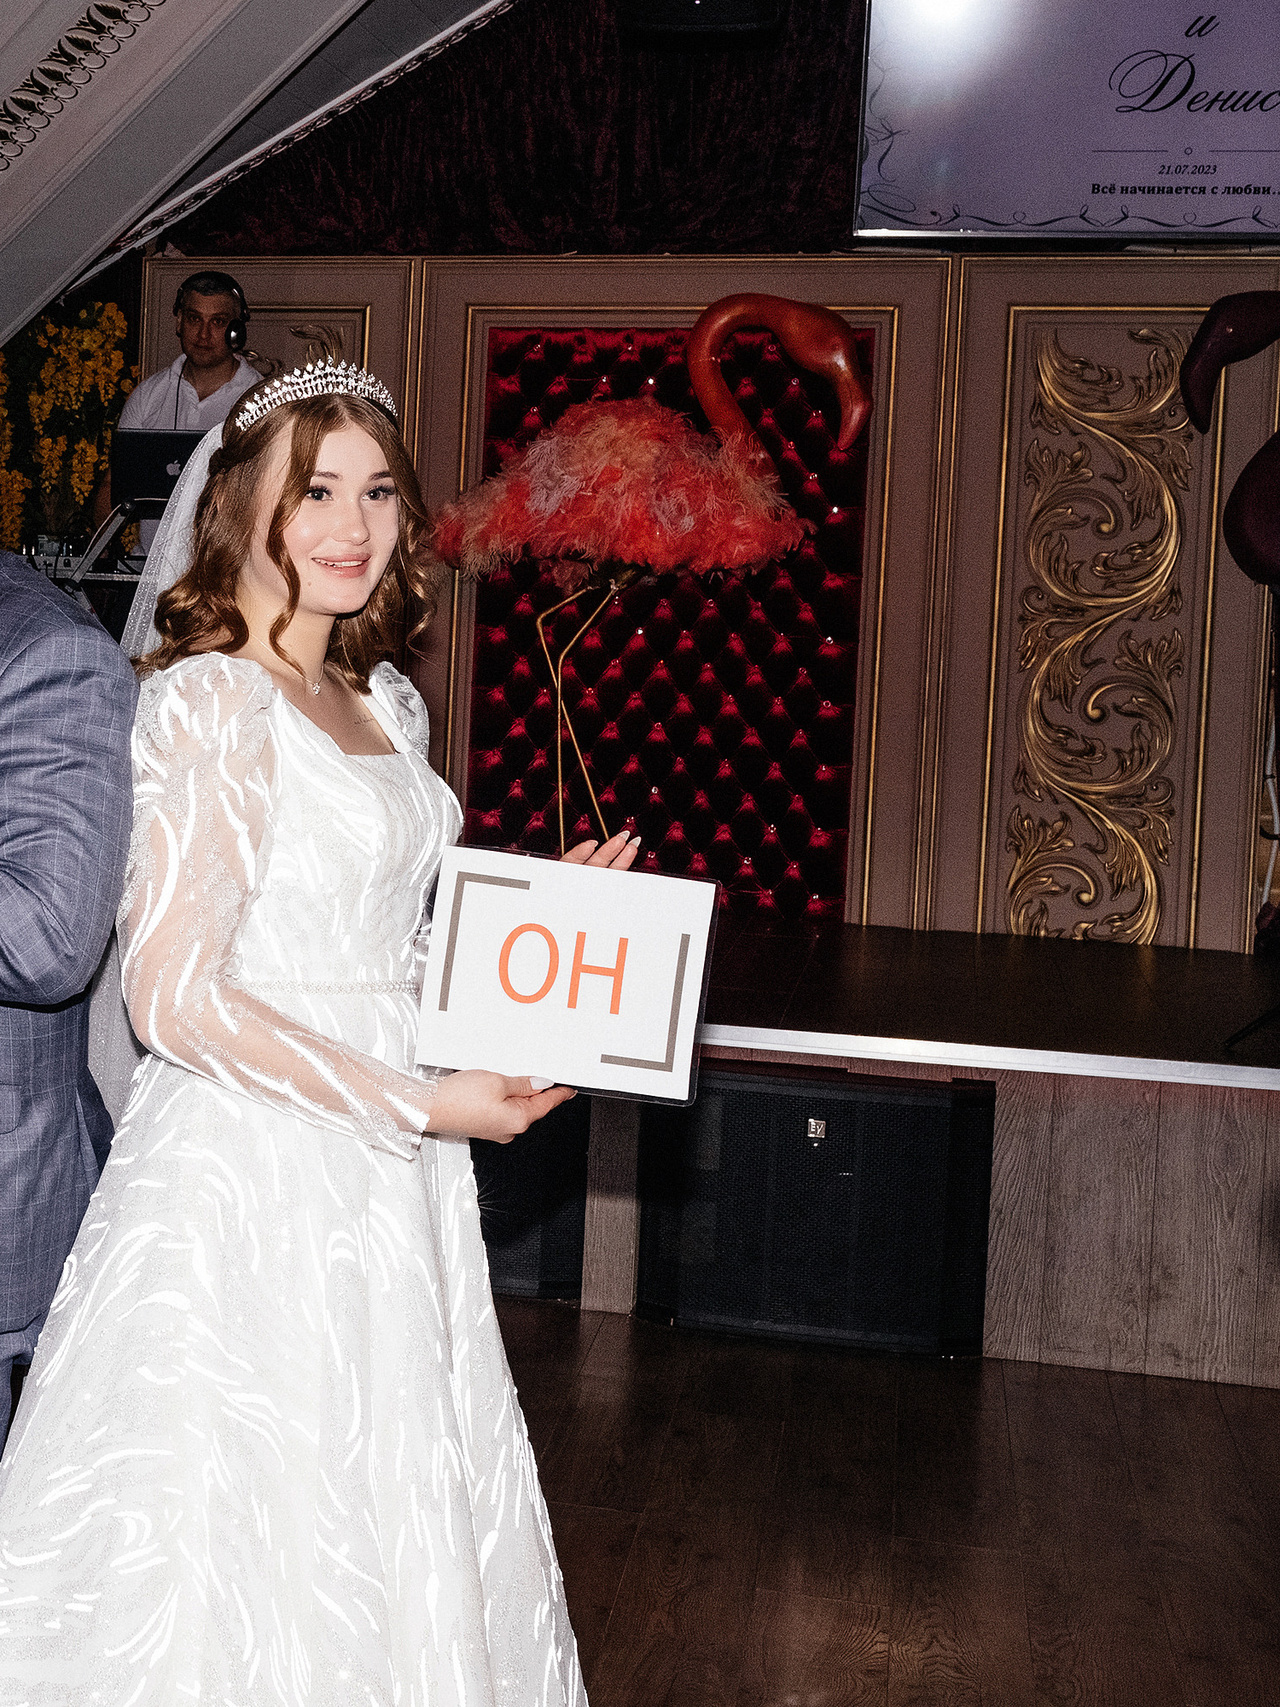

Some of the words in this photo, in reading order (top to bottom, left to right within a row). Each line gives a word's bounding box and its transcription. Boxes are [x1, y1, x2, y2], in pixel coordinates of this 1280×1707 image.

[1109, 50, 1280, 113] Денис
[1158, 164, 1218, 175] 21.07.2023
[1091, 183, 1116, 195] Всё
[1120, 184, 1207, 195] начинается
[1210, 185, 1219, 195] с
[498, 922, 629, 1015] ОН
